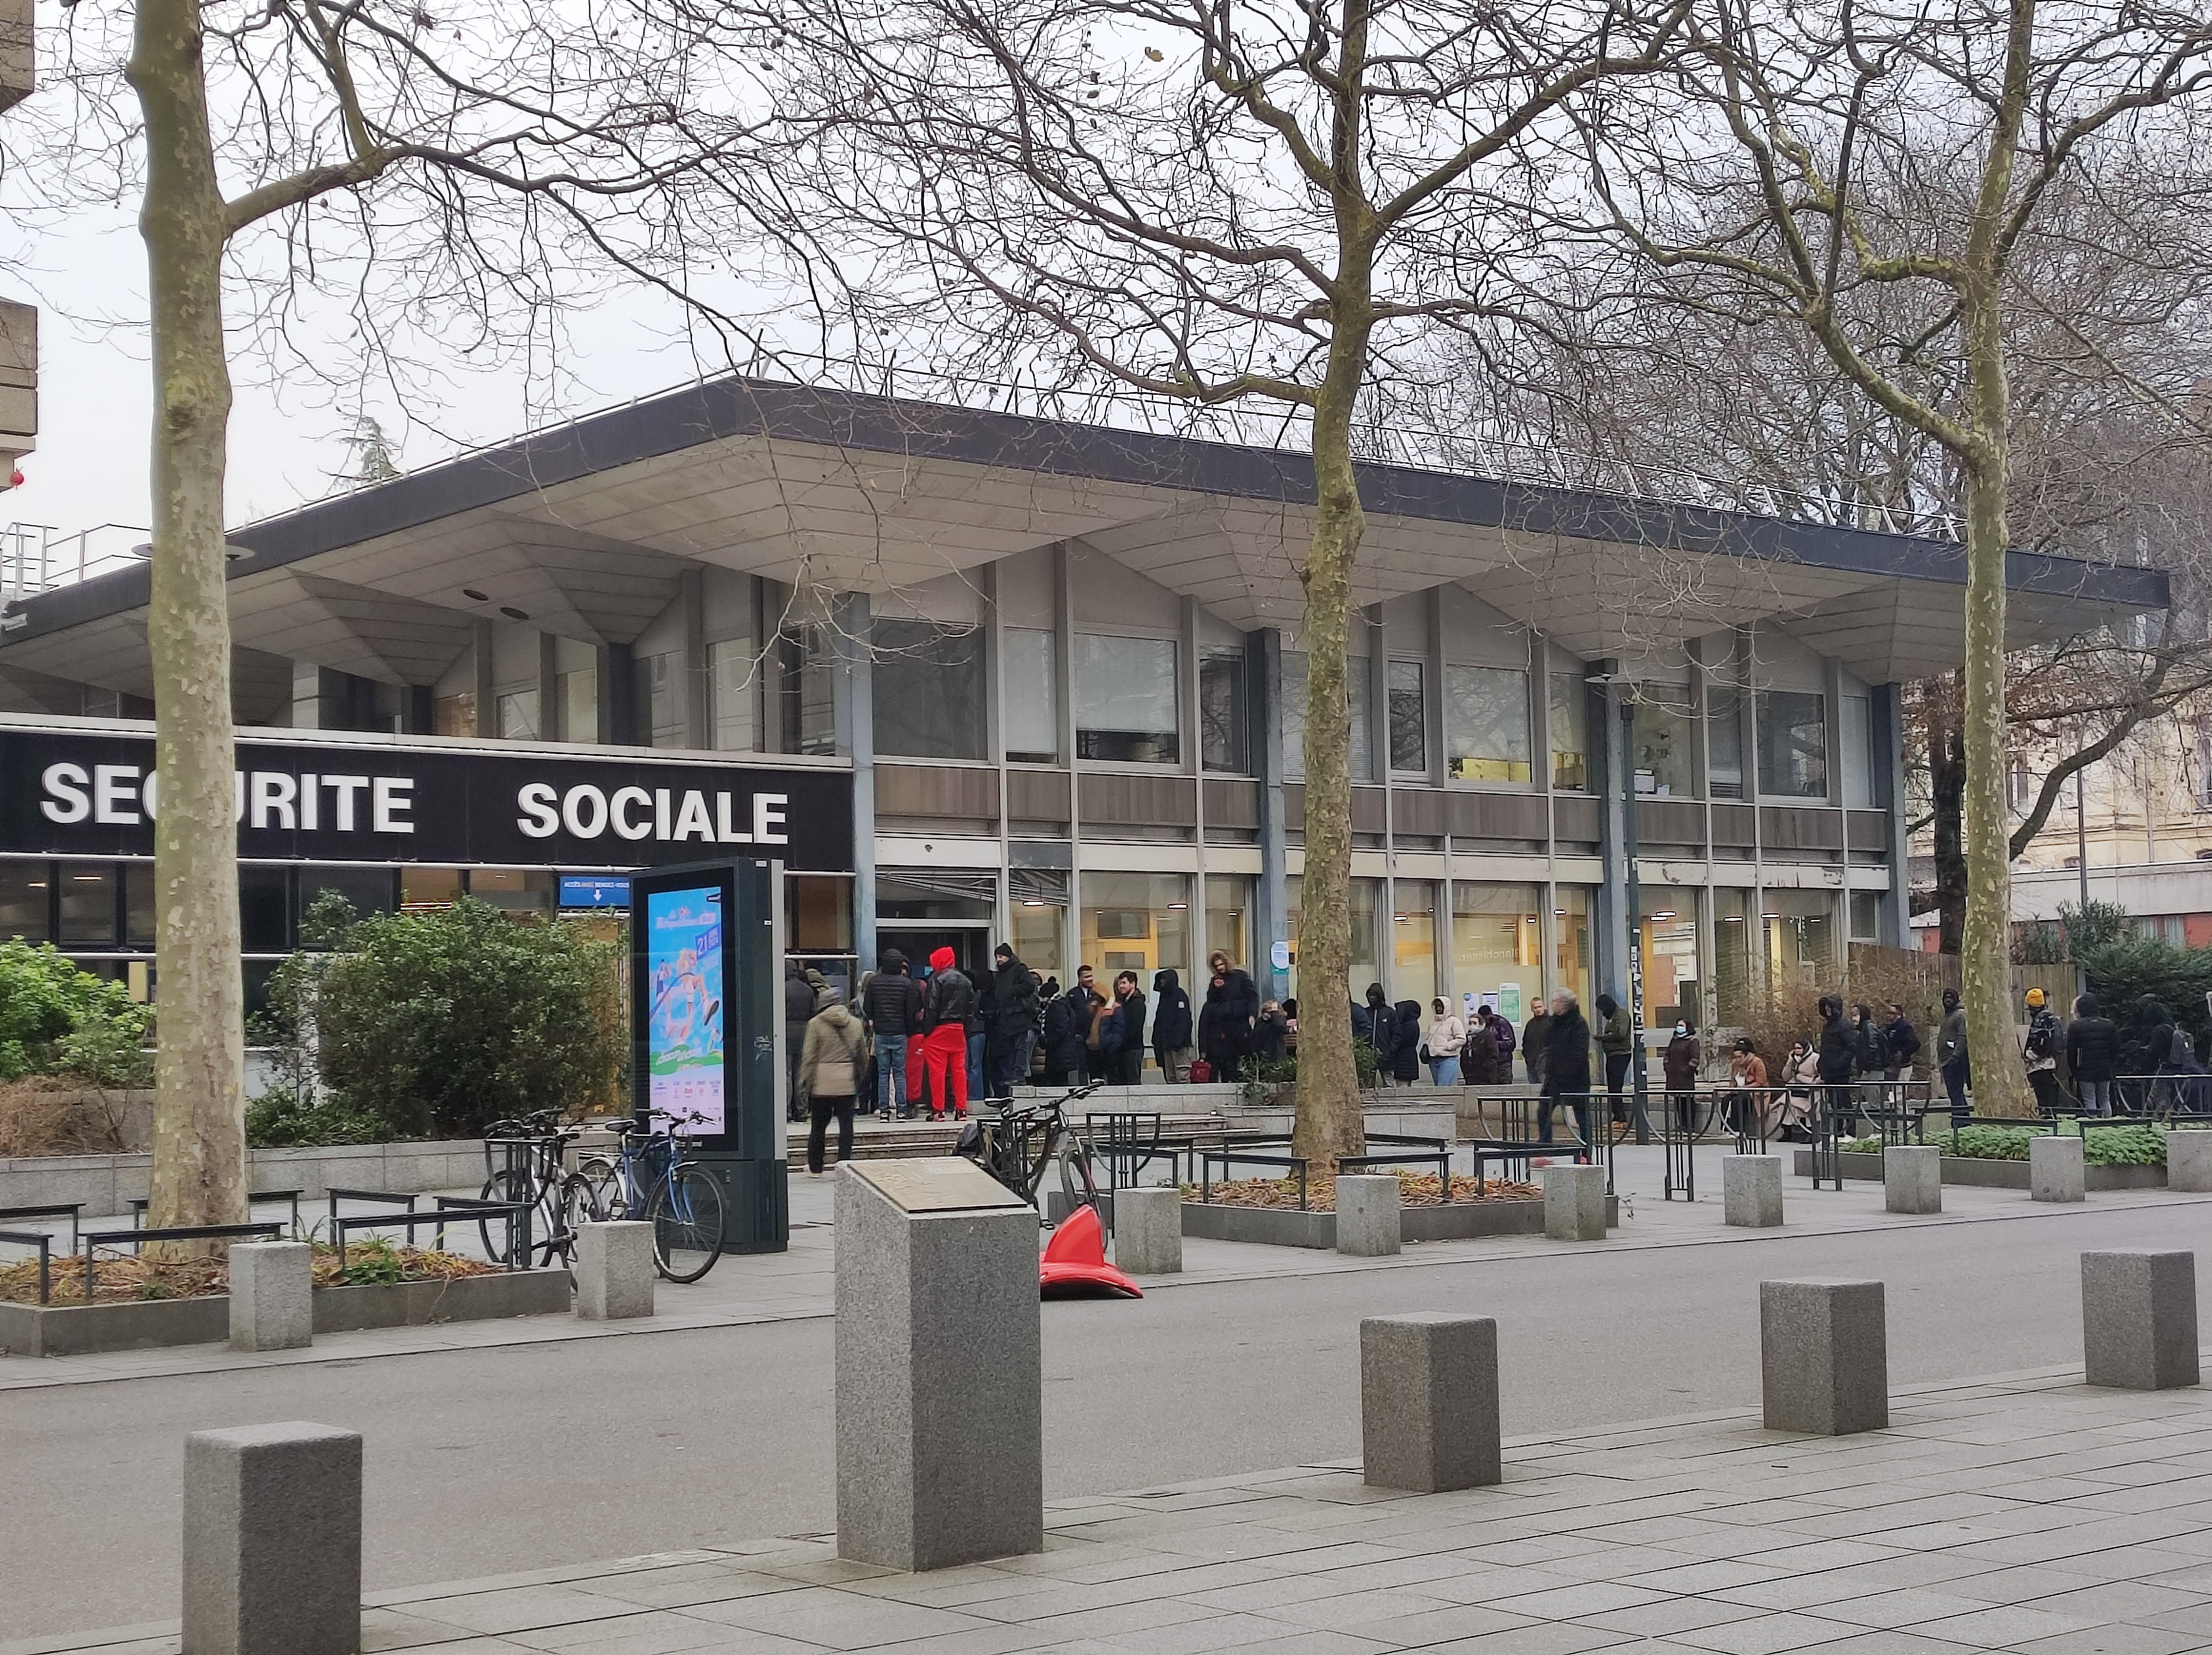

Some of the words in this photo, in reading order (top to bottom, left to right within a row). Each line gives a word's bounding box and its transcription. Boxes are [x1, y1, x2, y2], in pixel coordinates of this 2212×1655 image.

[40, 762, 415, 834] SERITE
[517, 782, 789, 845] SOCIALE
[697, 935, 707, 956] 21
